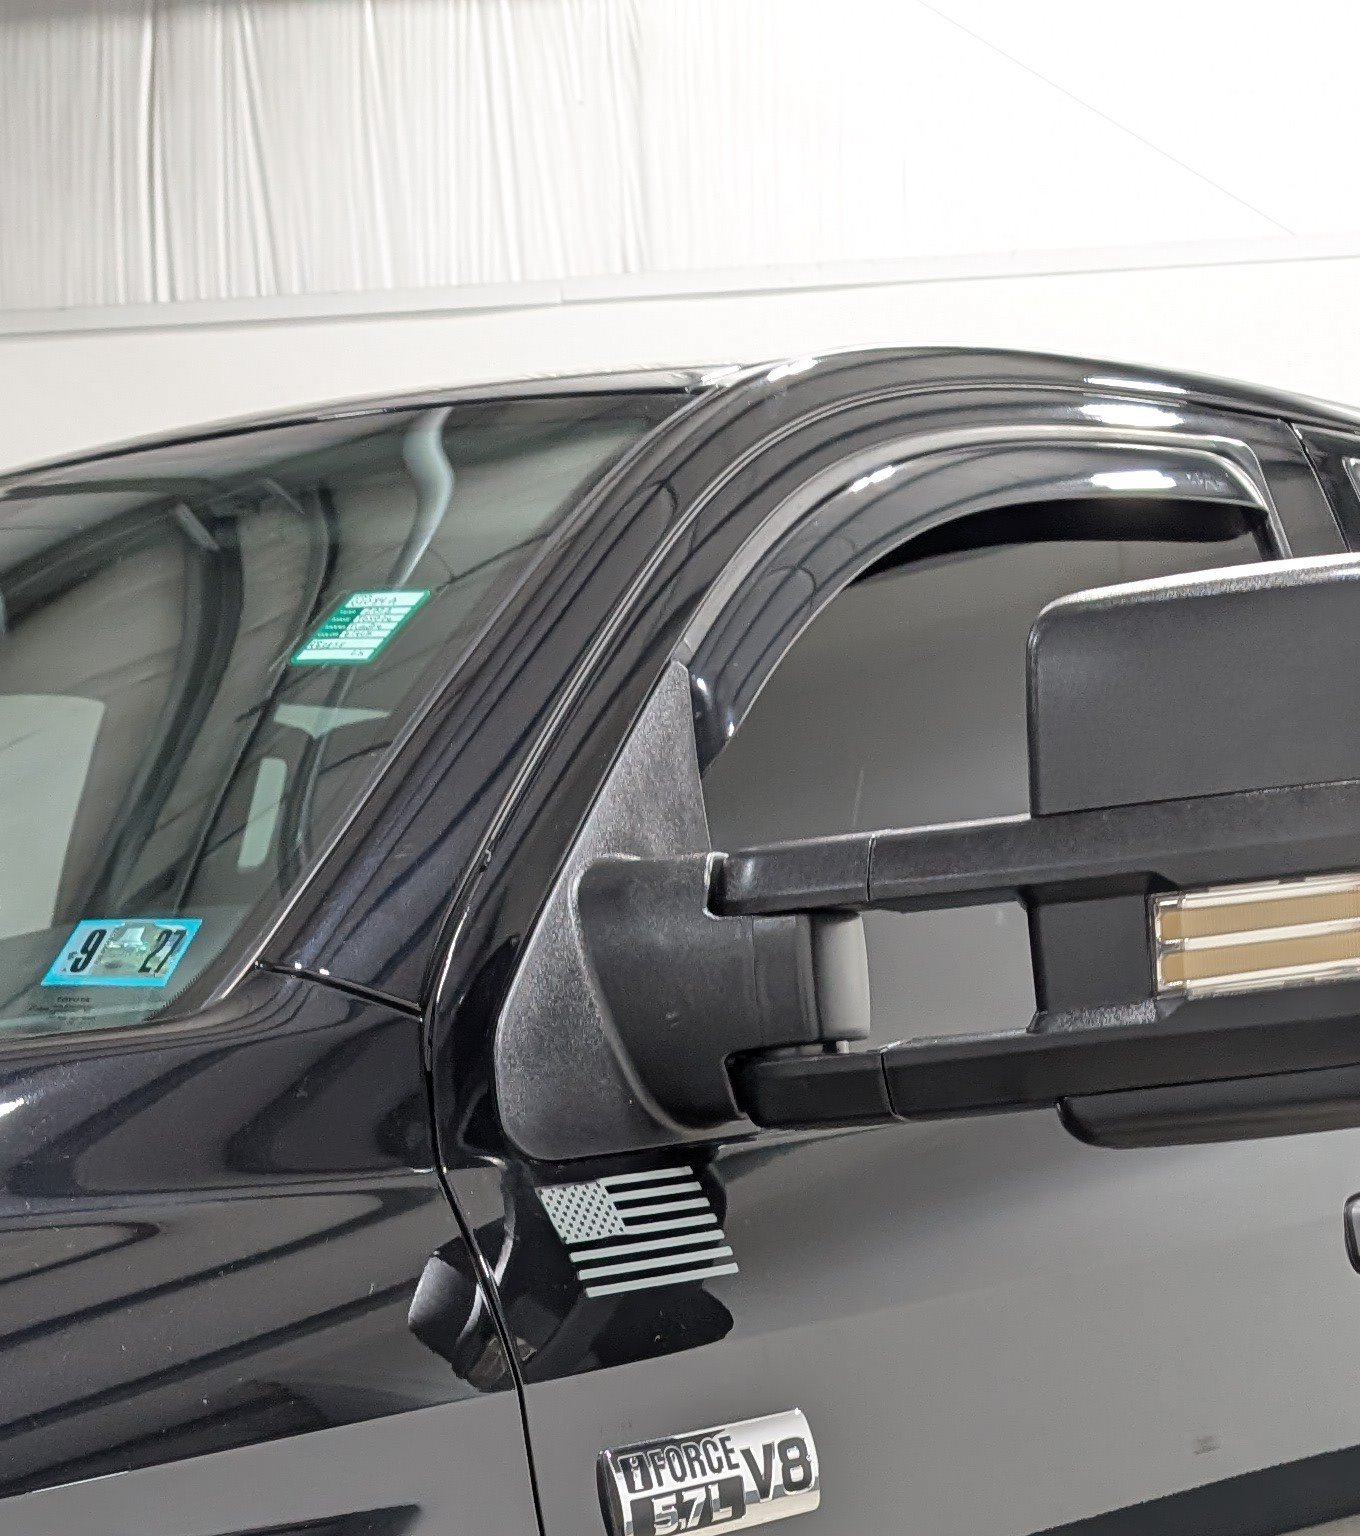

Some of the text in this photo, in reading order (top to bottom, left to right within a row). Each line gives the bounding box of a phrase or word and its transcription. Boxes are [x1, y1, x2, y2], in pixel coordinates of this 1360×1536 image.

[69, 928, 188, 974] 9 27
[740, 1436, 815, 1504] V8
